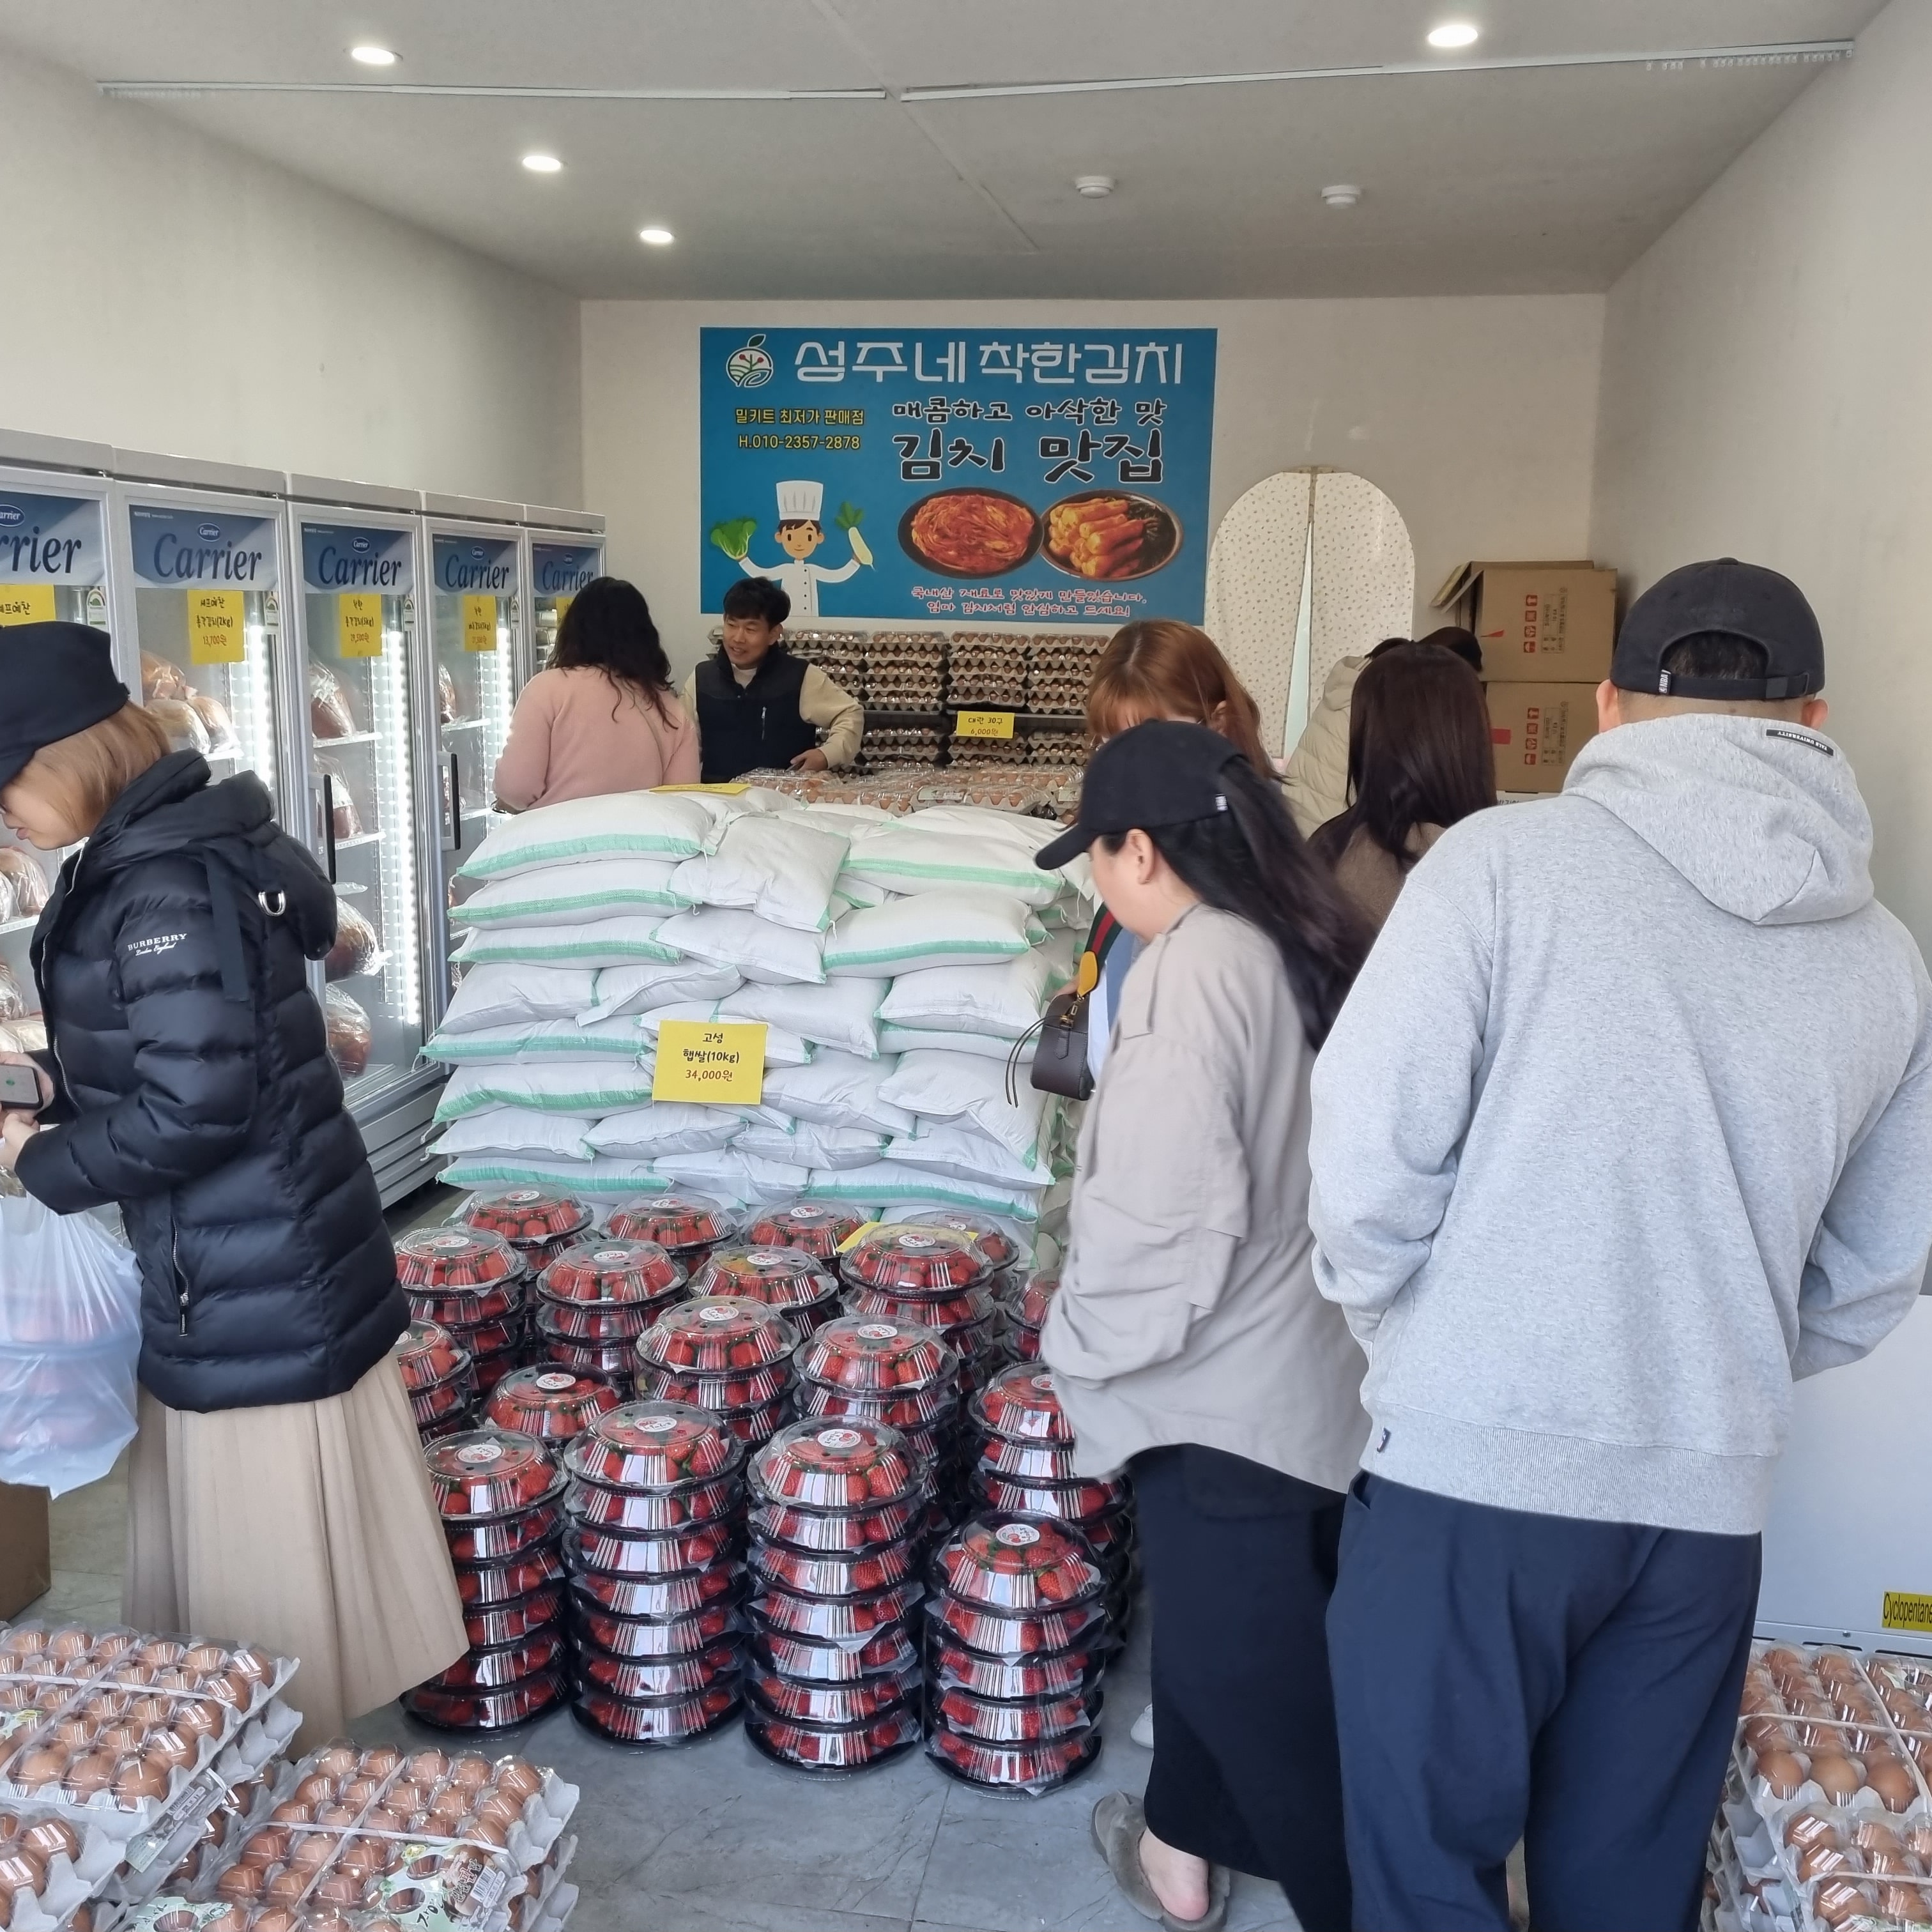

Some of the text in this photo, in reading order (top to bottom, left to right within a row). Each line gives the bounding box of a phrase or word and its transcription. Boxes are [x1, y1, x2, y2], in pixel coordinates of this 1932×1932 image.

[795, 341, 1183, 384] 성주네 착한김치
[735, 408, 864, 425] 밀키트 최저가 판매점
[893, 396, 1167, 426] 매콤하고 아삭한 맛
[739, 435, 861, 449] H.010-2357-2878
[893, 427, 1163, 483] 김치 맛집
[153, 533, 262, 581] Carrier
[319, 546, 401, 586] Carrier
[446, 554, 509, 589] Carrier
[911, 586, 953, 599] 국내산
[959, 586, 1004, 599] 재료로
[1009, 588, 1053, 602] 맛있게
[926, 601, 955, 613] 엄마
[961, 601, 1016, 615] 김치처럼
[1022, 602, 1078, 616] 안심하고
[1659, 674, 1669, 687] NBA
[968, 716, 1002, 725] 대란 30구
[128, 933, 188, 951] BURBERRY
[702, 1032, 723, 1044] 고성
[682, 1048, 740, 1064] 햅쌀(10kg)
[685, 1069, 733, 1082] 34,000원
